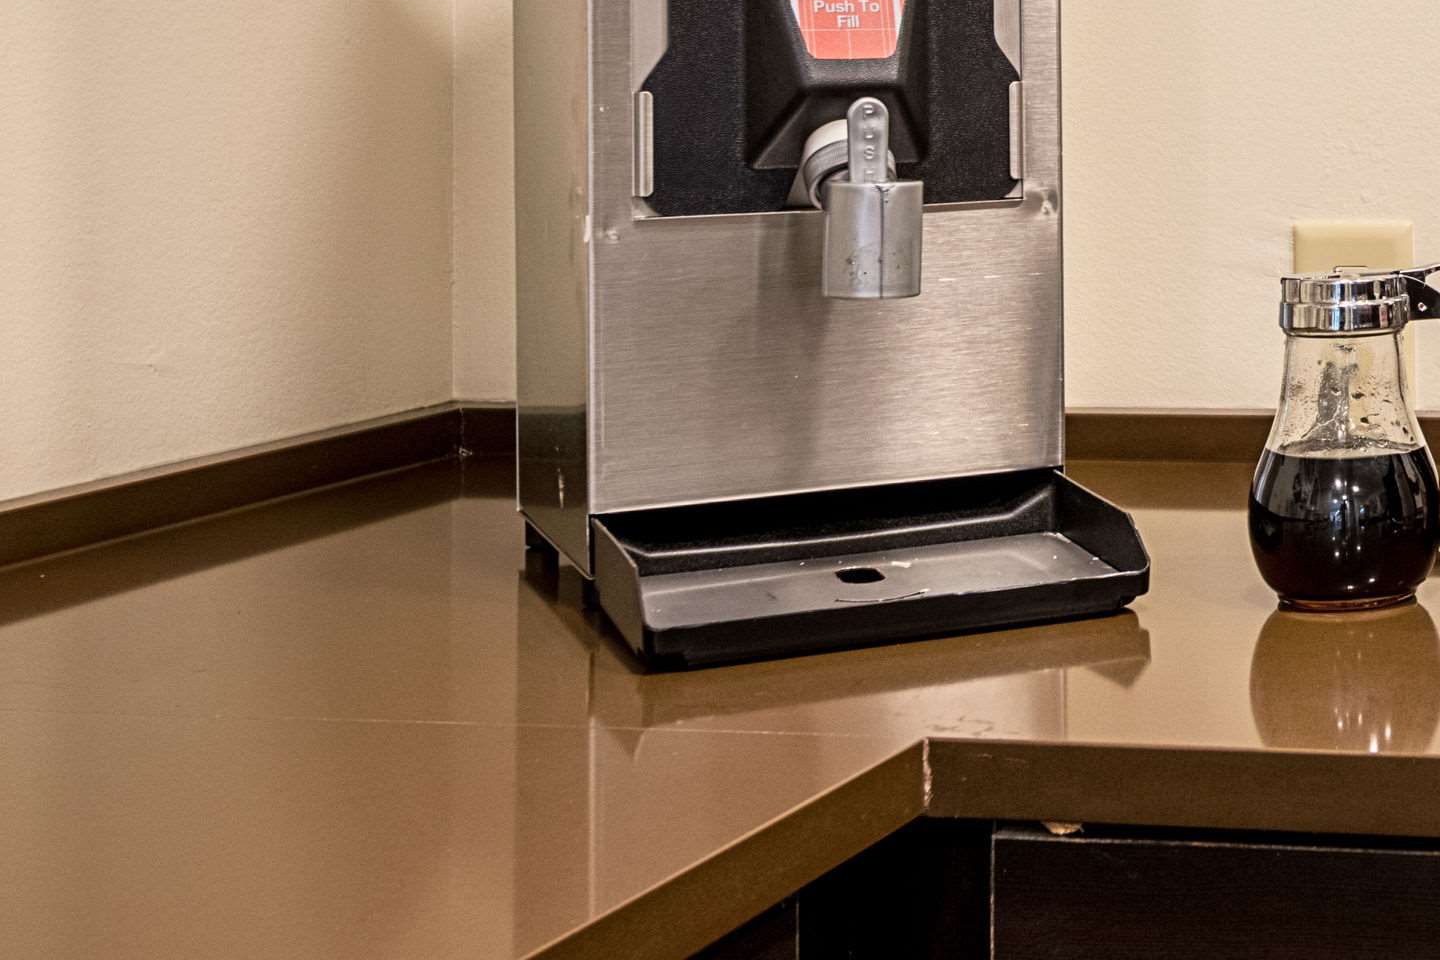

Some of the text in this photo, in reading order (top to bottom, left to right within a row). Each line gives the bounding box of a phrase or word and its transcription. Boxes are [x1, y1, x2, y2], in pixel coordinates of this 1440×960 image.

[813, 0, 880, 13] Push To
[836, 15, 860, 28] Fill
